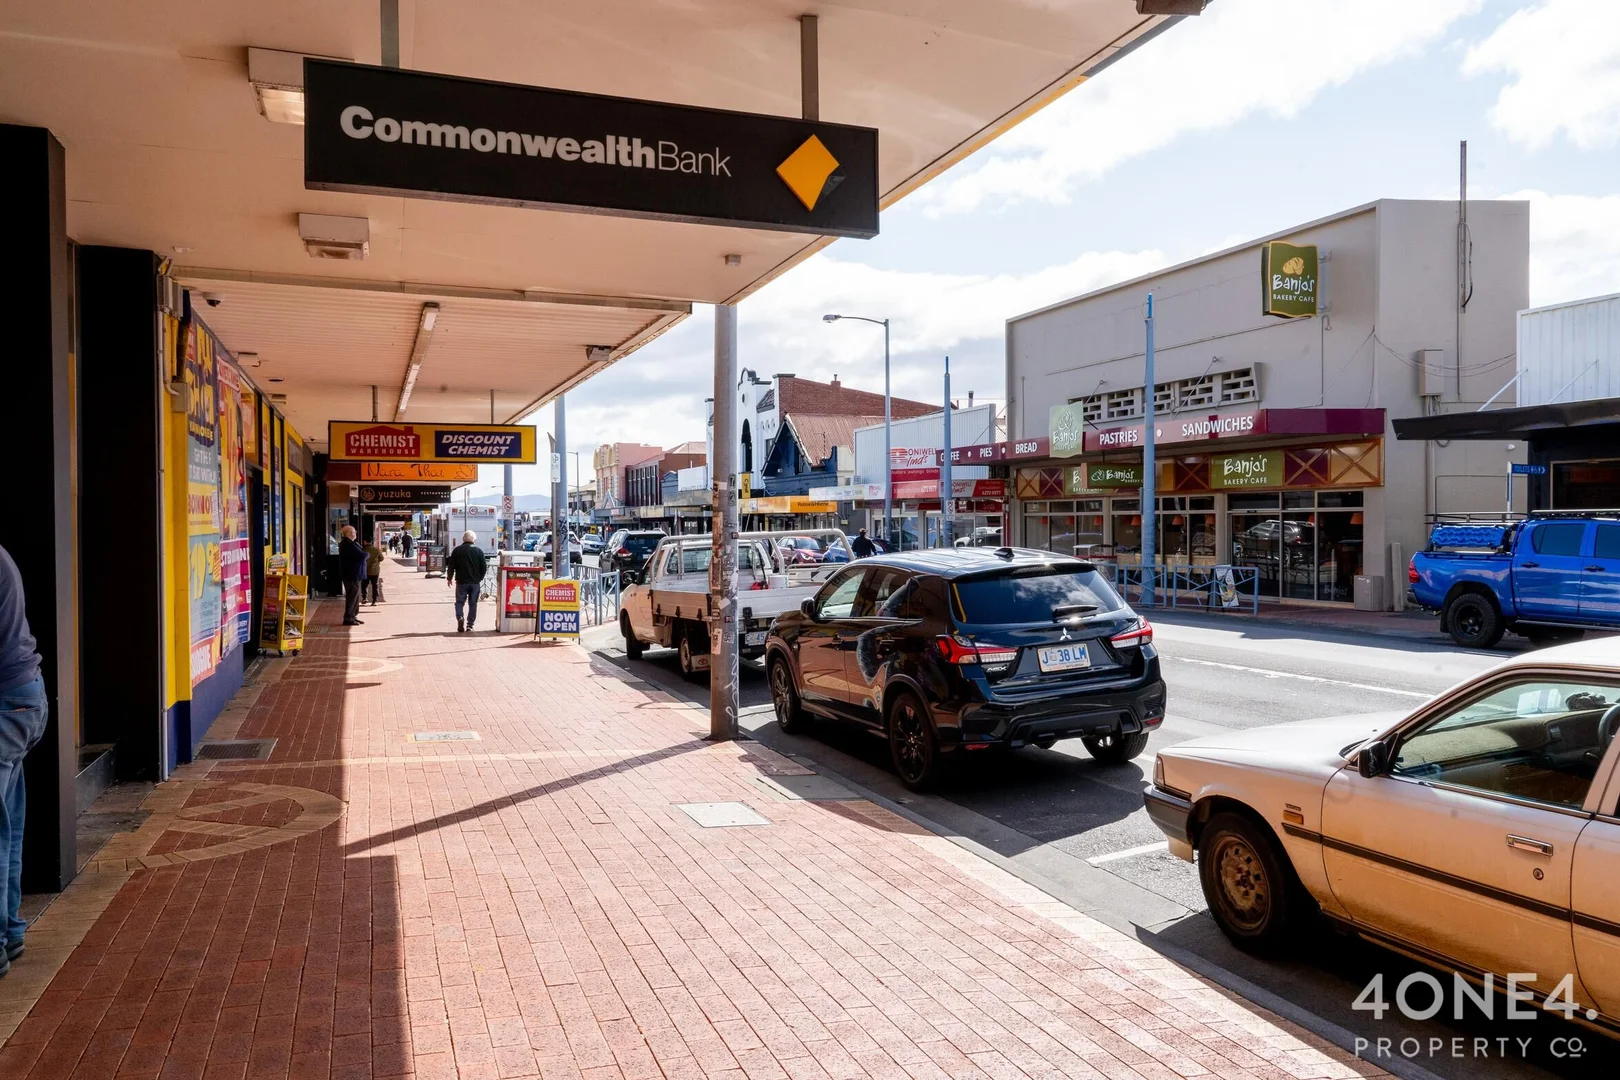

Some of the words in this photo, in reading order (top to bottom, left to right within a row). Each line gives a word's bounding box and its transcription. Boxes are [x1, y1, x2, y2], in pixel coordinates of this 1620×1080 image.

[340, 105, 731, 178] CommonwealthBank
[1272, 274, 1315, 295] Banjo's
[1181, 416, 1254, 437] SANDWICHES
[350, 434, 416, 448] CHEMIST
[441, 434, 515, 445] DISCOUNT
[1053, 428, 1078, 445] Banjo's
[1099, 430, 1138, 445] PASTRIES
[448, 445, 509, 455] CHEMIST
[979, 447, 993, 458] PIES
[1015, 442, 1038, 454] BREAD
[940, 451, 960, 461] CFEE
[1223, 455, 1268, 477] Banjo's
[1106, 469, 1135, 481] Banjo's
[1223, 478, 1249, 486] BAKERY
[1250, 477, 1268, 485] CAFE
[378, 489, 412, 500] yuzuka
[545, 589, 575, 597] CHEMIST
[544, 612, 577, 622] NOW
[543, 622, 577, 632] OPEN
[1042, 651, 1049, 664] J
[1057, 649, 1070, 662] 38
